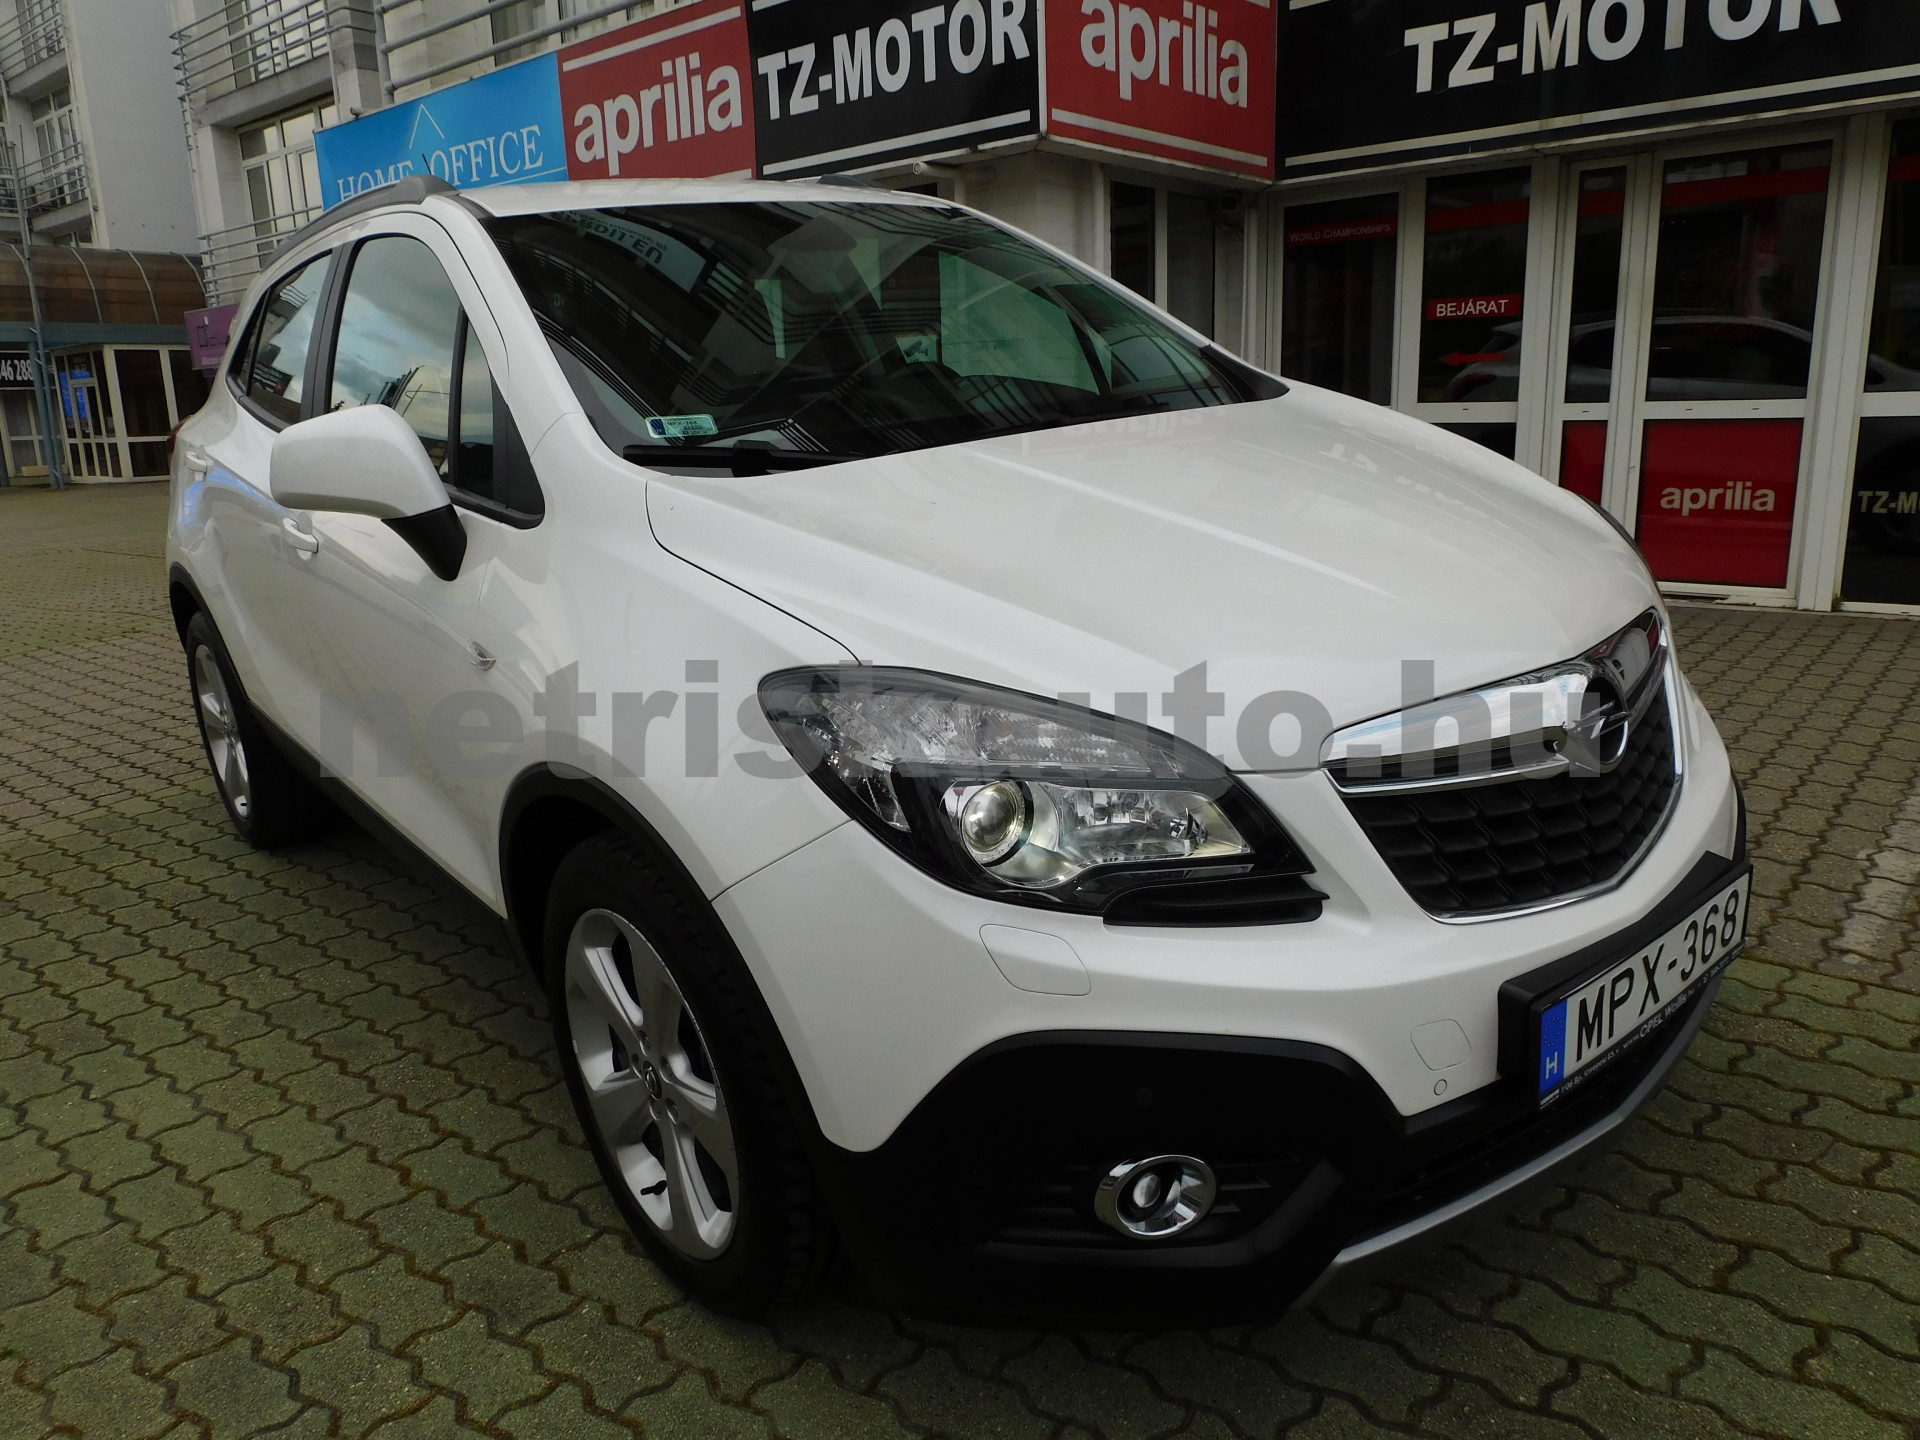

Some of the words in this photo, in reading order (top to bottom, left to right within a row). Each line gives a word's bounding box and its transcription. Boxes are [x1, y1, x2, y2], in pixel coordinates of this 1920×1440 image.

[757, 0, 1030, 121] TZ-MOTOR
[1080, 0, 1248, 109] aprilia
[573, 52, 743, 177] aprilia
[430, 124, 544, 186] OFFICE
[1290, 231, 1320, 243] WORLD
[1323, 223, 1391, 239] CHAMPIONSHIPS
[1436, 298, 1509, 317] BEJÁRAT
[1660, 481, 1776, 517] aprilia
[1857, 490, 1920, 514] TZ-M
[1576, 889, 1740, 1063] MPX-368
[1545, 1051, 1559, 1079] H
